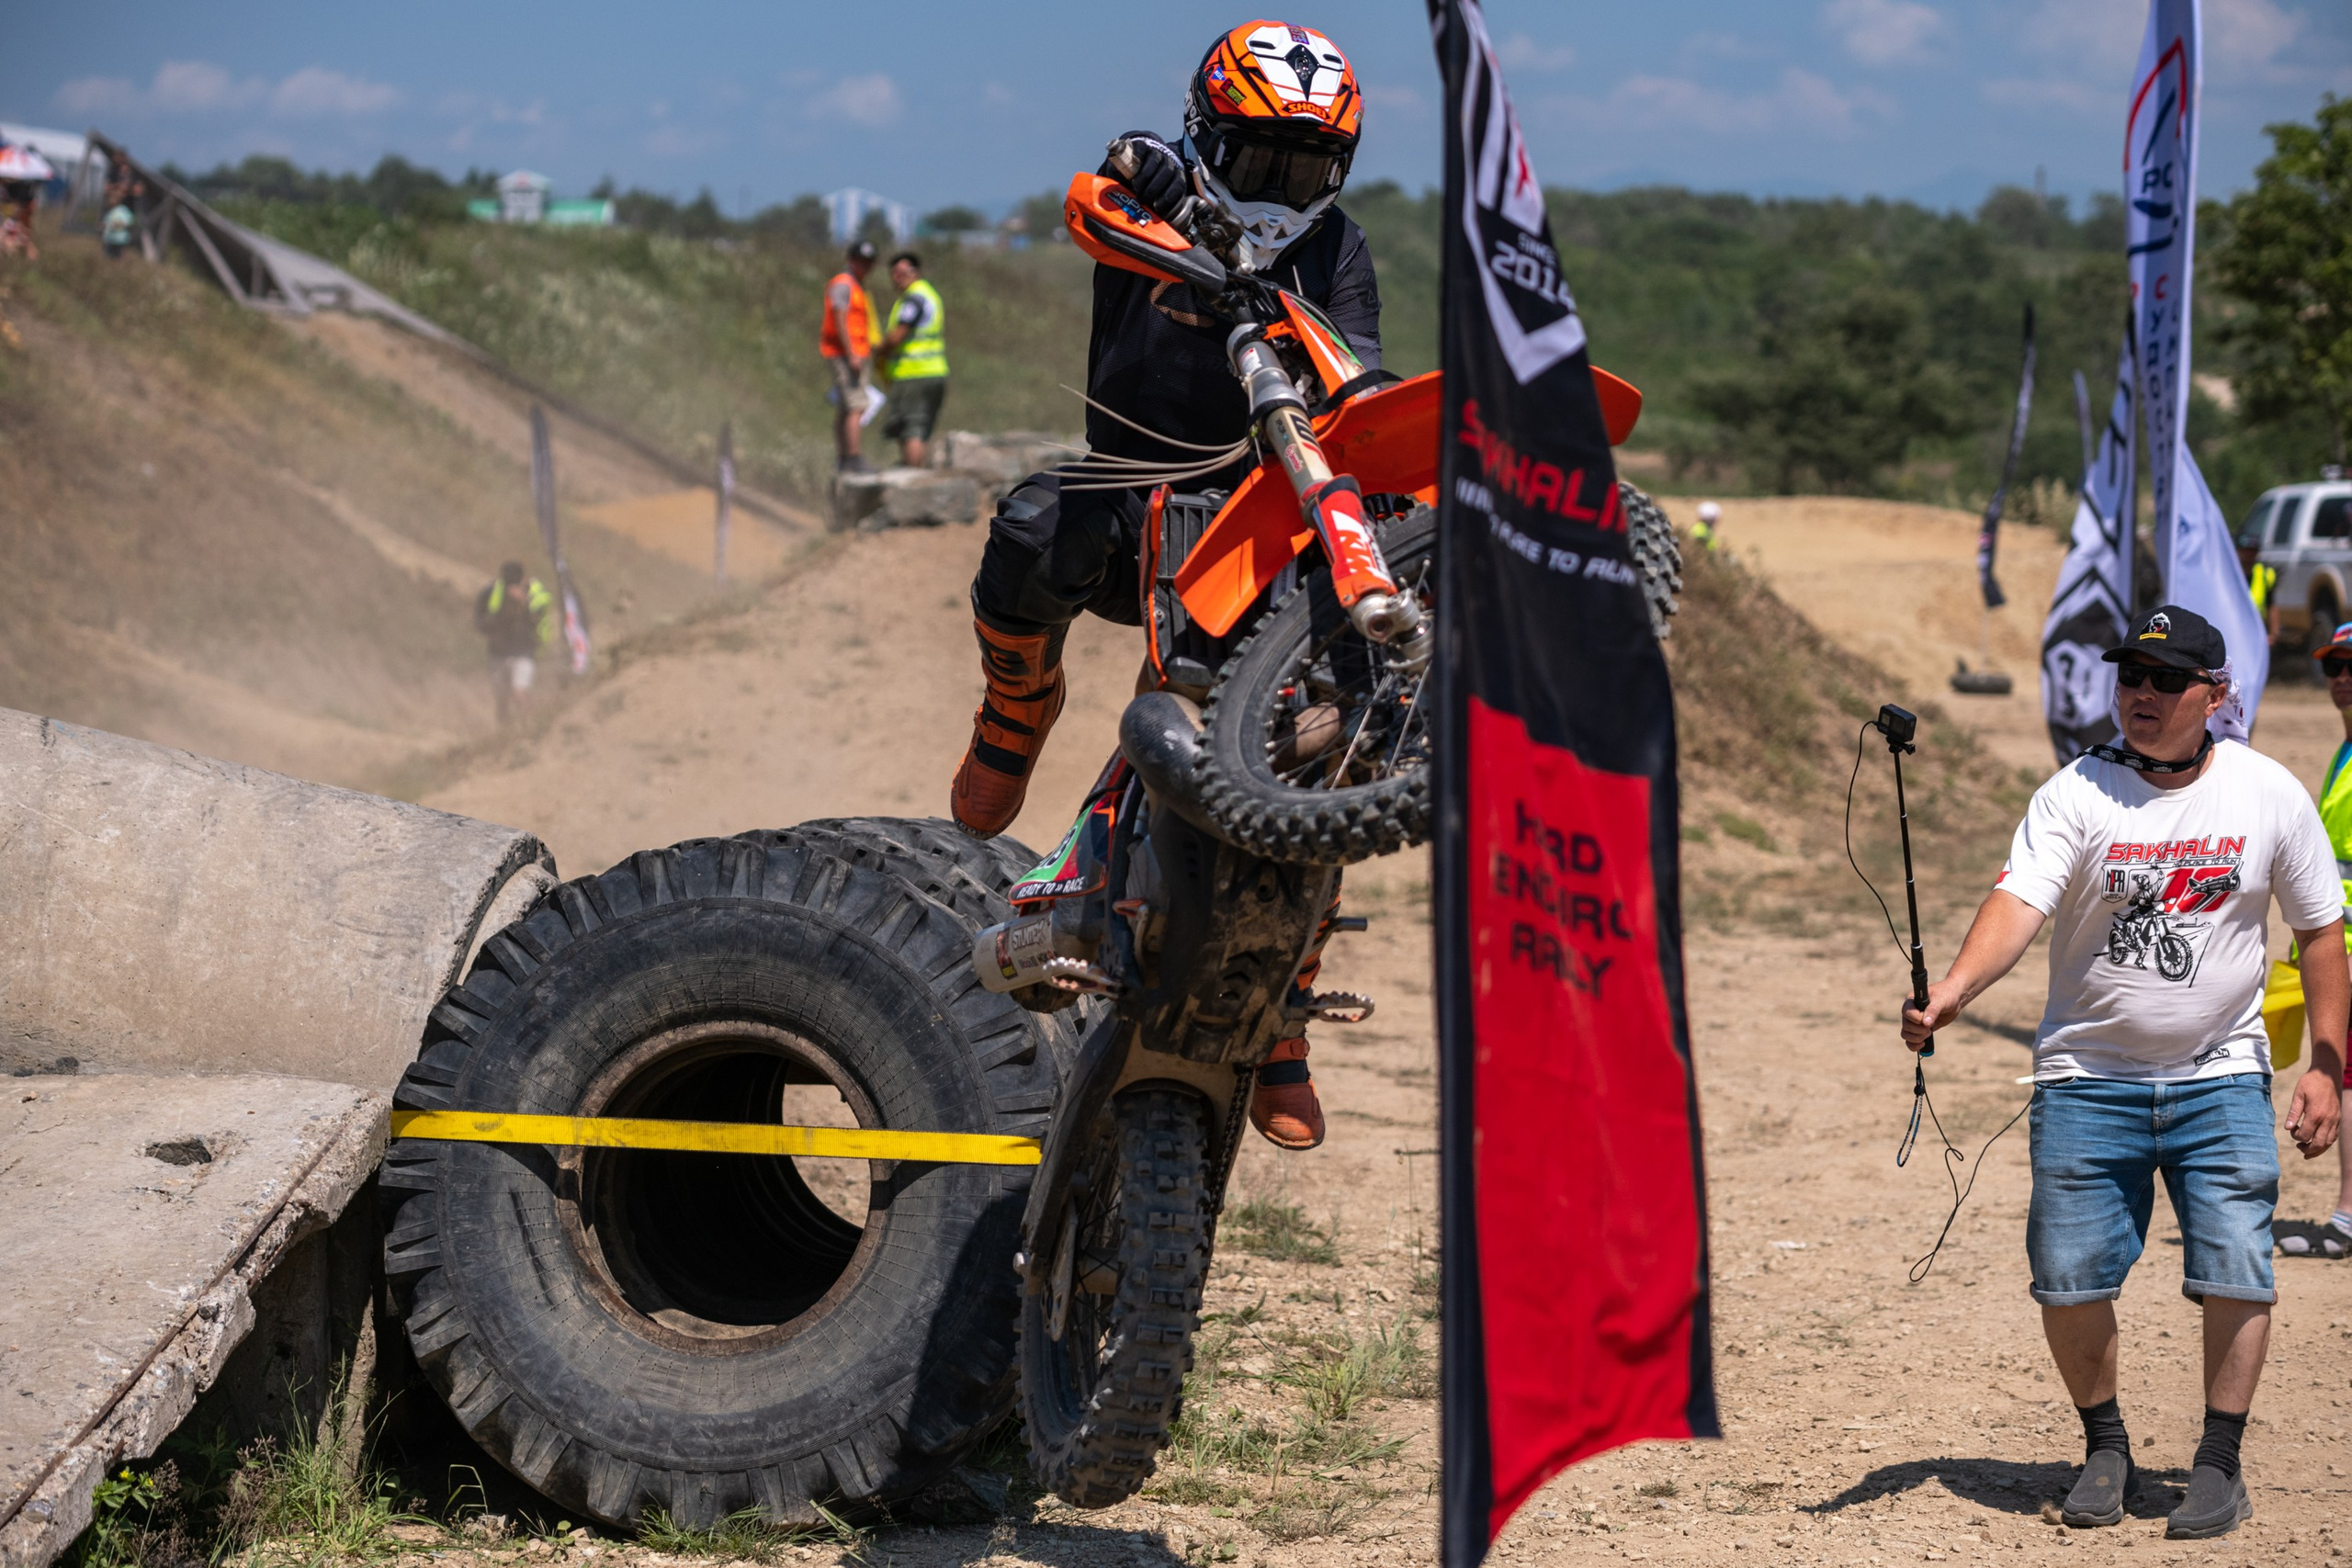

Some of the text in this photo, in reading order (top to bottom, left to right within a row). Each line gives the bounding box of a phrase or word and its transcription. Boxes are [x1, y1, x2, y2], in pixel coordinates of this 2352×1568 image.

[1287, 103, 1328, 119] SHOEI
[1547, 547, 1581, 575] TO
[2105, 835, 2245, 863] SAKHALIN
[1016, 876, 1085, 899] READY TO RACE
